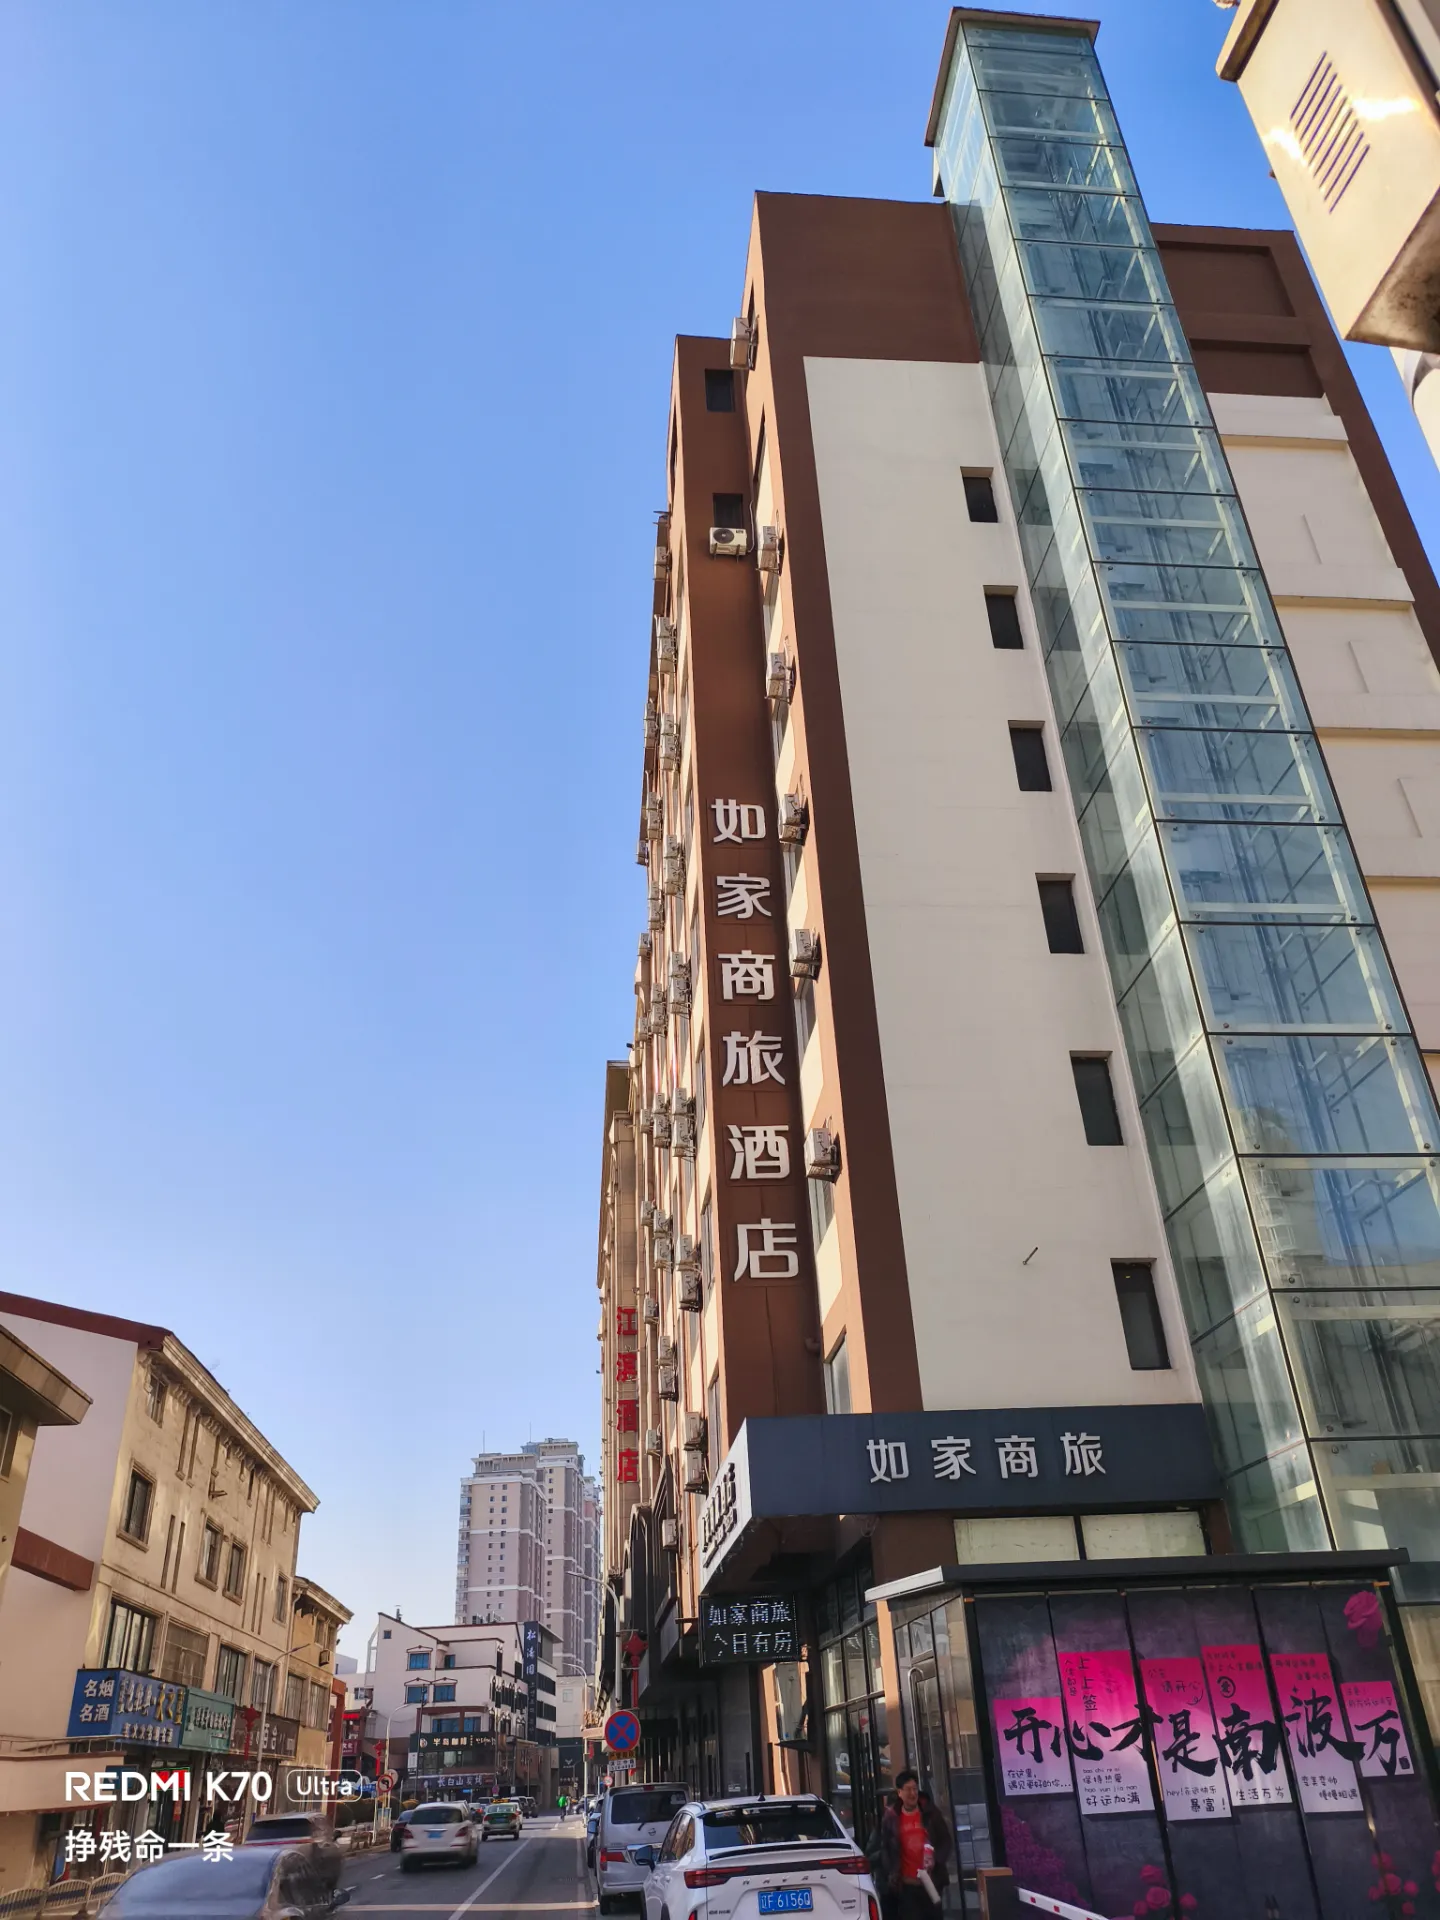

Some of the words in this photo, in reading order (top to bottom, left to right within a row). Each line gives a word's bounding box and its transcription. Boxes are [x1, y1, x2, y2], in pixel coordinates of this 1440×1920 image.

[711, 798, 799, 1280] 如家商旅酒店
[867, 1432, 1106, 1483] 如家商旅
[708, 1601, 792, 1626] 如家商旅
[84, 1679, 115, 1698] 名烟
[1078, 1656, 1098, 1711] 上上签
[79, 1704, 110, 1722] 名酒
[1003, 1687, 1400, 1781] 开心才是南波万
[1086, 1792, 1141, 1807] 好运加满
[1235, 1786, 1285, 1801] 生活万岁
